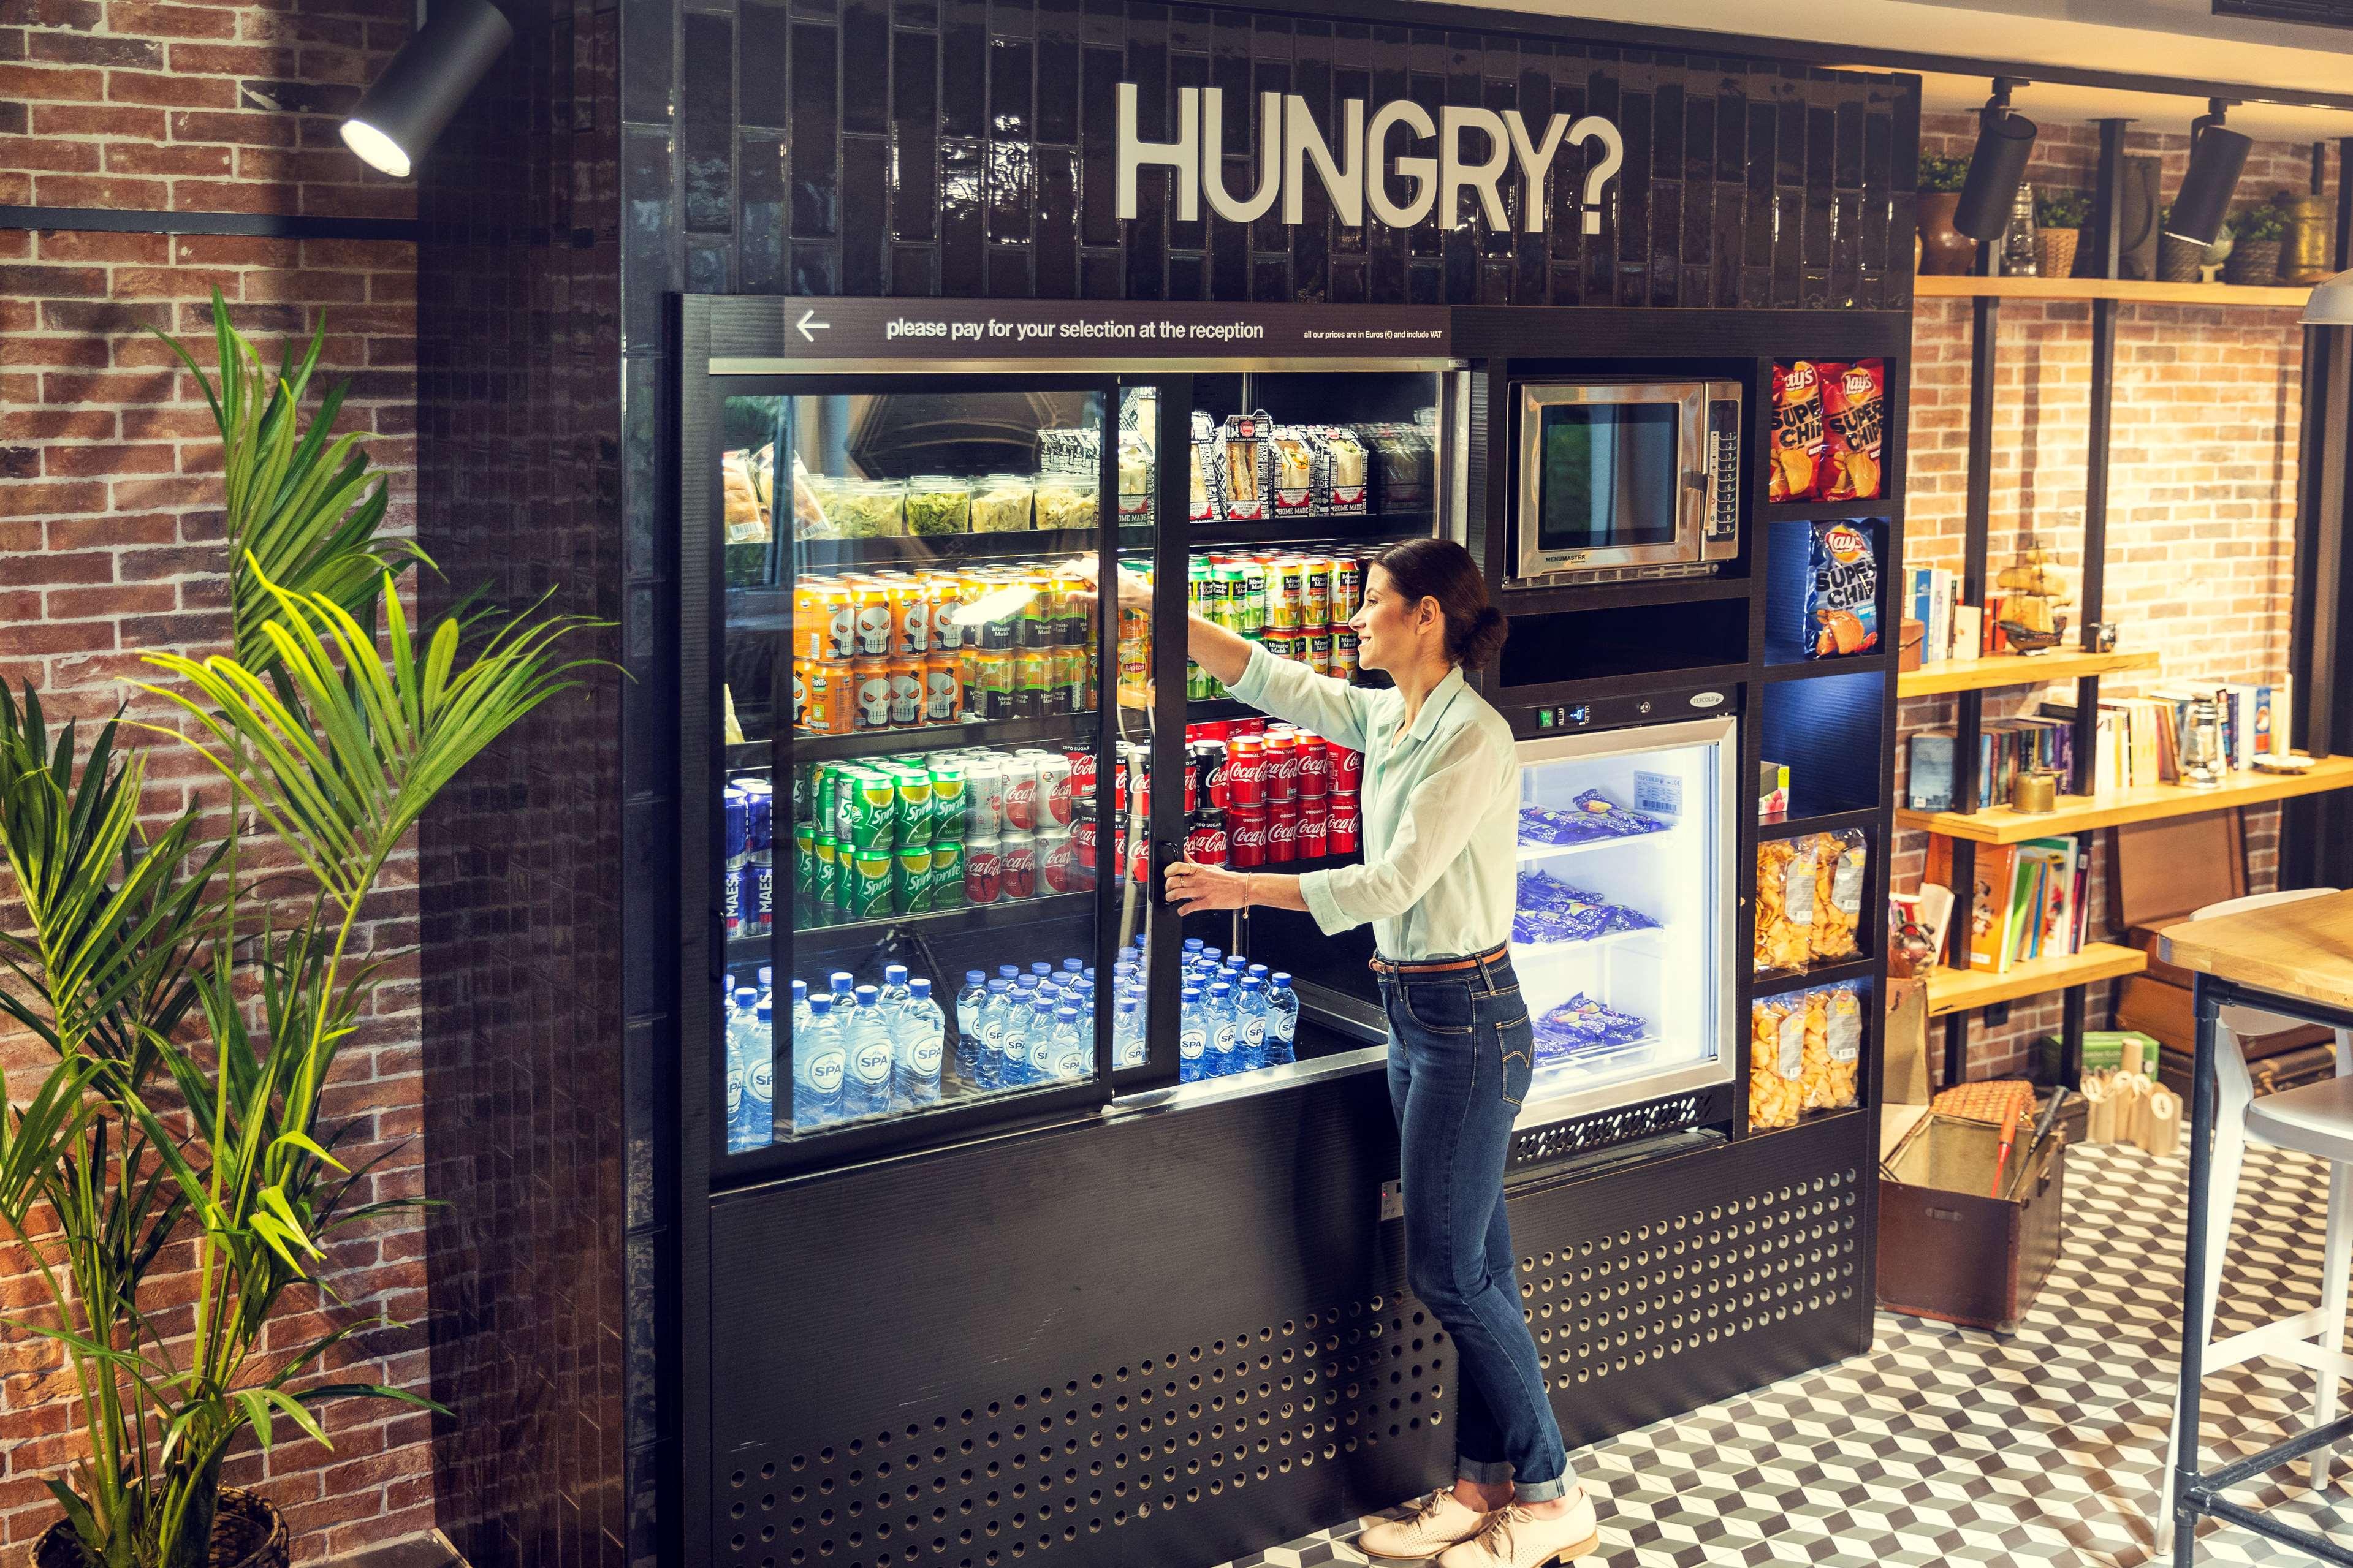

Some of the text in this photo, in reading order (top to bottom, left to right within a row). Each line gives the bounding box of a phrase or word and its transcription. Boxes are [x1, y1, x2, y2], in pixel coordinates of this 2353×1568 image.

[1116, 83, 1624, 235] HUNGRY?
[887, 317, 1263, 342] please pay for your selection at the reception
[1325, 331, 1345, 339] prices
[726, 878, 739, 917] MAES
[759, 874, 772, 913] MAES
[861, 1056, 888, 1067] SPA
[918, 1047, 941, 1059] SPA
[815, 1064, 842, 1077] SPA
